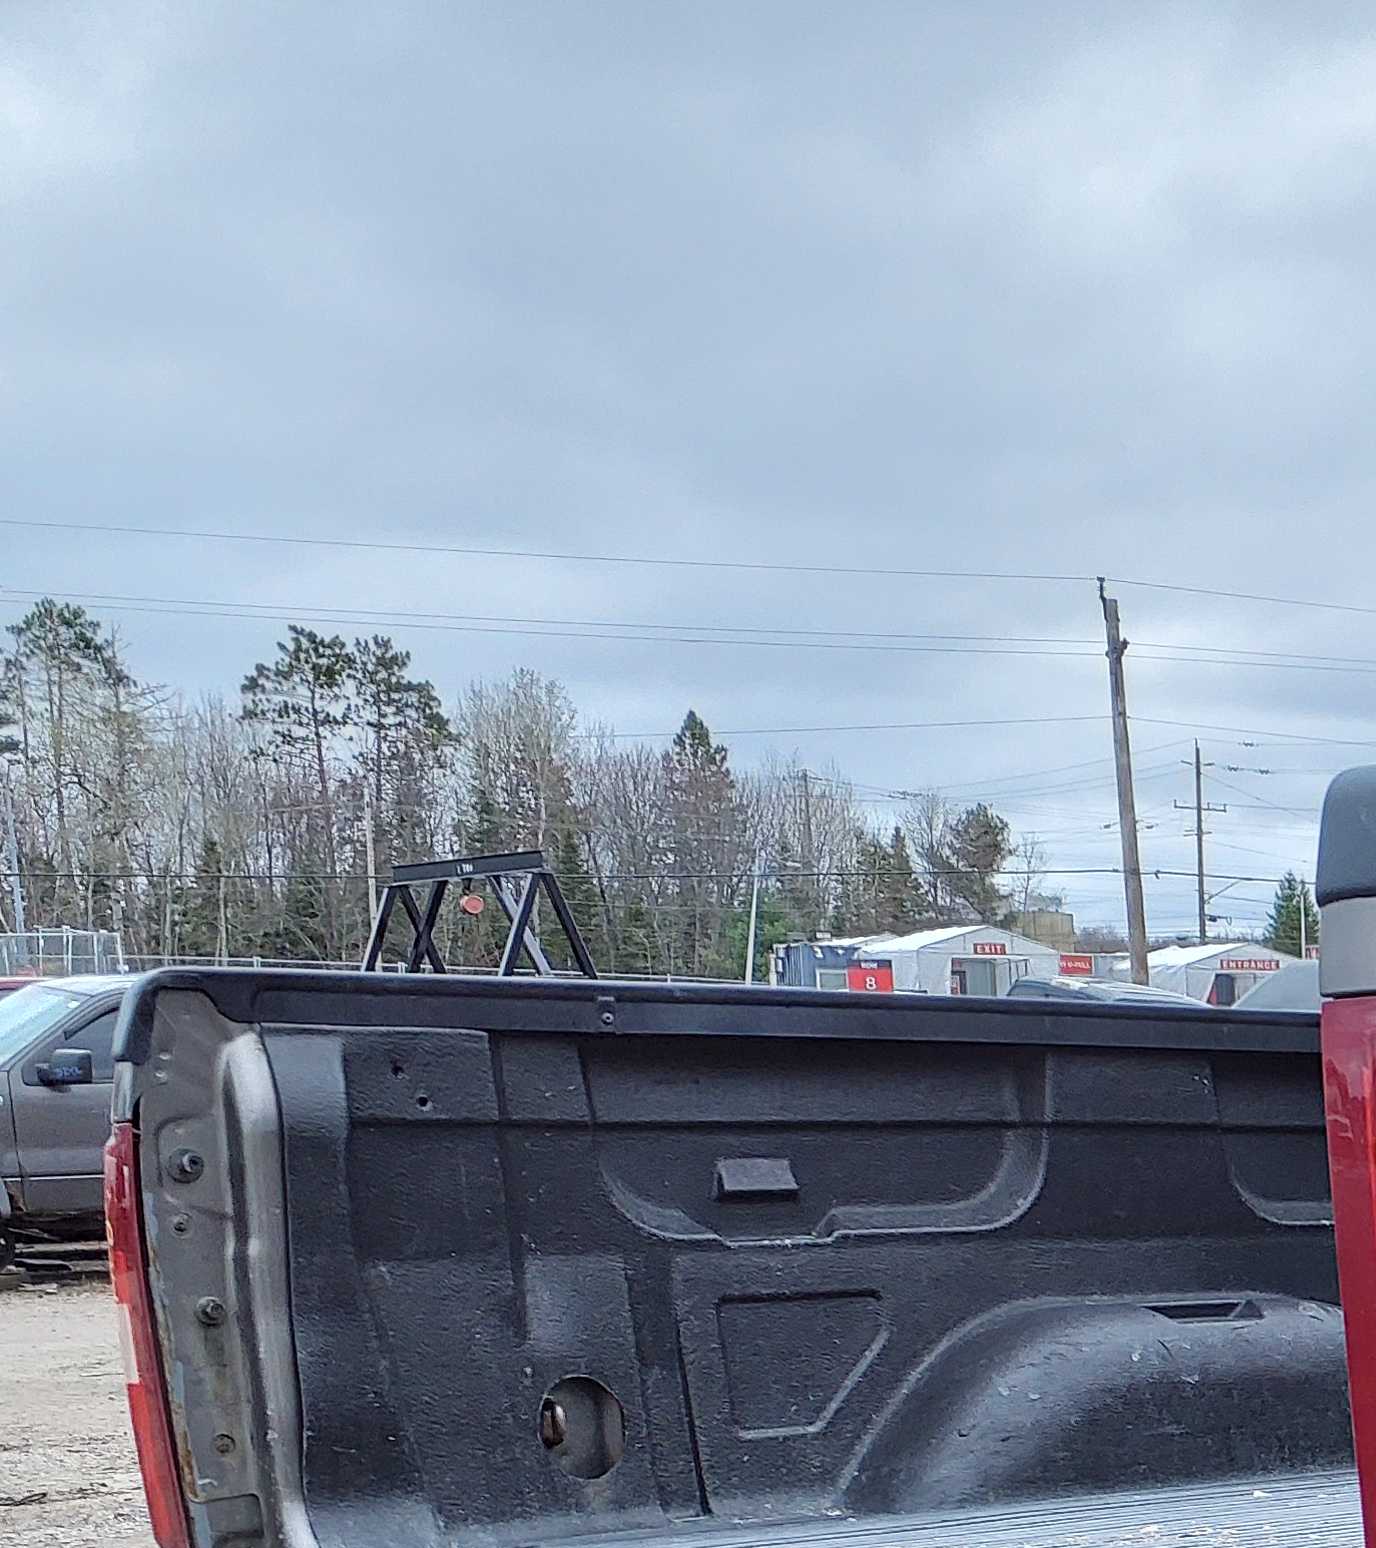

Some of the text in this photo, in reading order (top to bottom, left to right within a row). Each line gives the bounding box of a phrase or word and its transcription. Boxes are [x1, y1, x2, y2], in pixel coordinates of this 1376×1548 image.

[976, 943, 1003, 954] EXIT
[1222, 960, 1278, 970] ENTRANCE
[865, 976, 877, 990] 8
